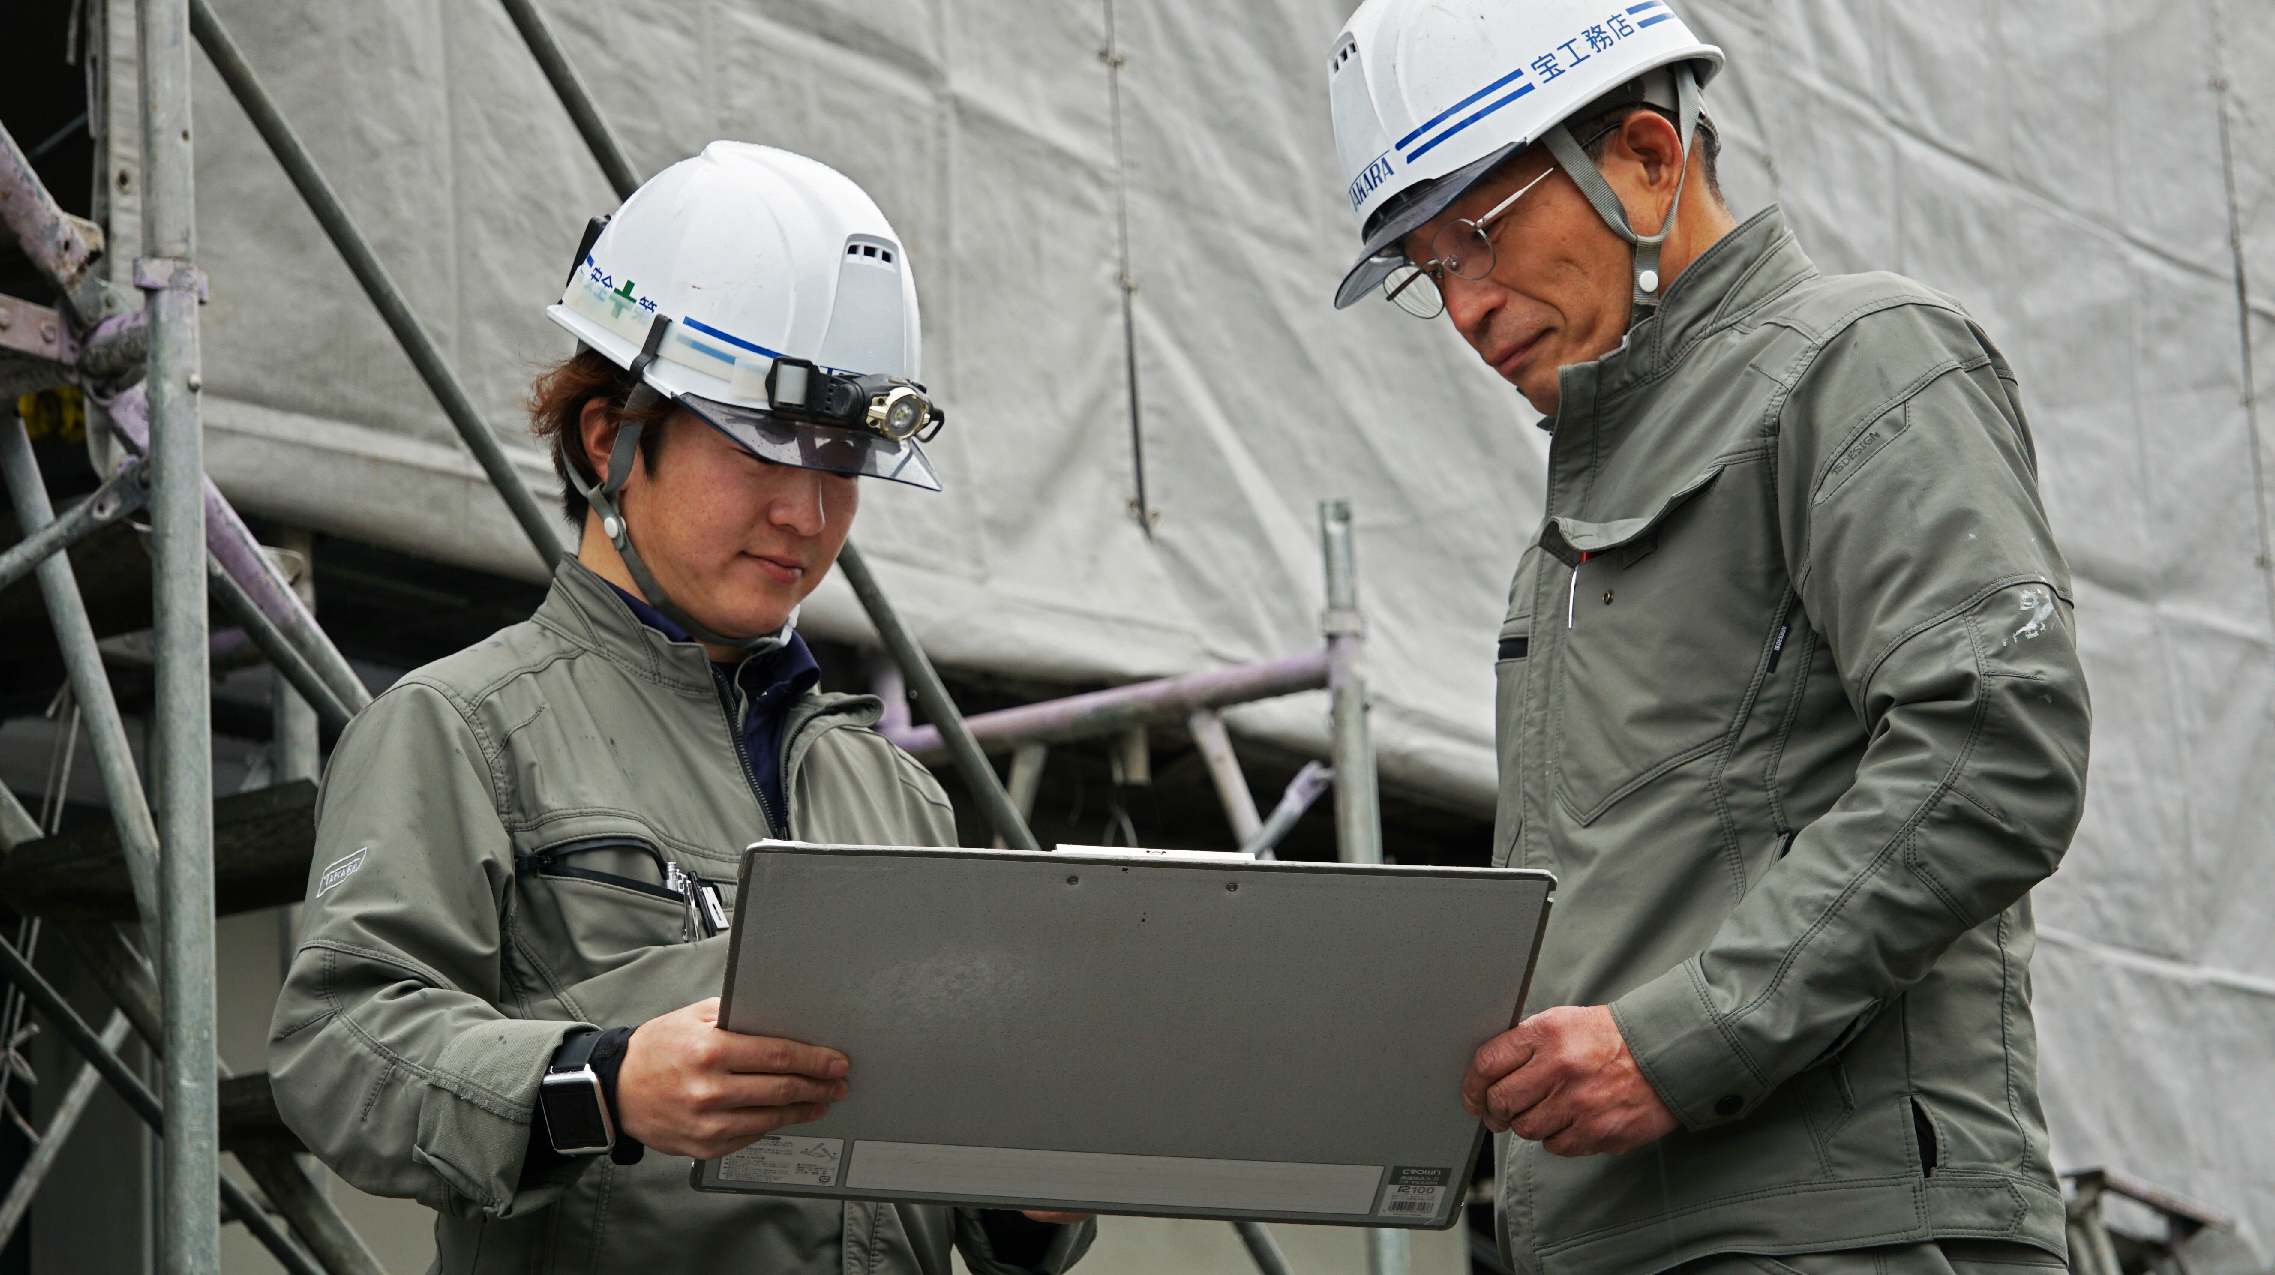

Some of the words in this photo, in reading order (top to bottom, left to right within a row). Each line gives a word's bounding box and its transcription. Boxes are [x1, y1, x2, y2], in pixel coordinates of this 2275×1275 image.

[1530, 13, 1636, 84] 宝工務店
[323, 858, 361, 887] TAKARA
